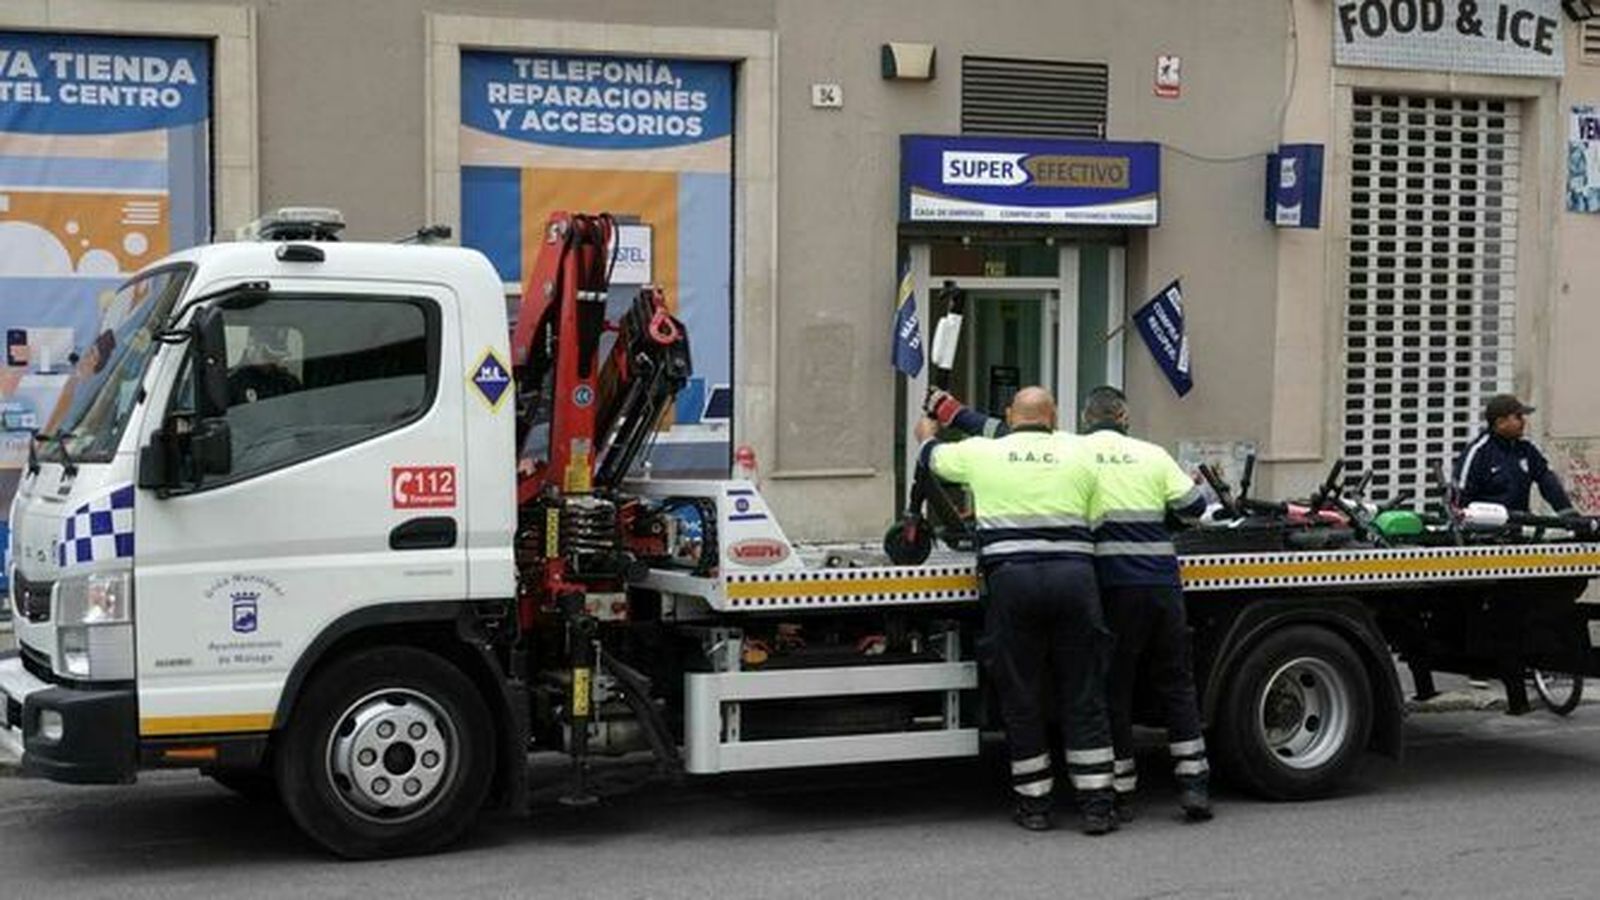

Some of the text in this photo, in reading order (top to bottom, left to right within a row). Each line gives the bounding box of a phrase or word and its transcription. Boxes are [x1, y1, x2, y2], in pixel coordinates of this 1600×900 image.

[1338, 0, 1557, 56] FOOD & ICE
[50, 53, 196, 84] TIENDA
[514, 58, 682, 88] TELEFONÍA,
[59, 84, 181, 108] CENTRO
[488, 82, 707, 111] REPARACIONES
[494, 108, 702, 136] Y ACCESORIOS
[950, 160, 1123, 182] SUPER EFECTIVO
[415, 472, 453, 493] 112
